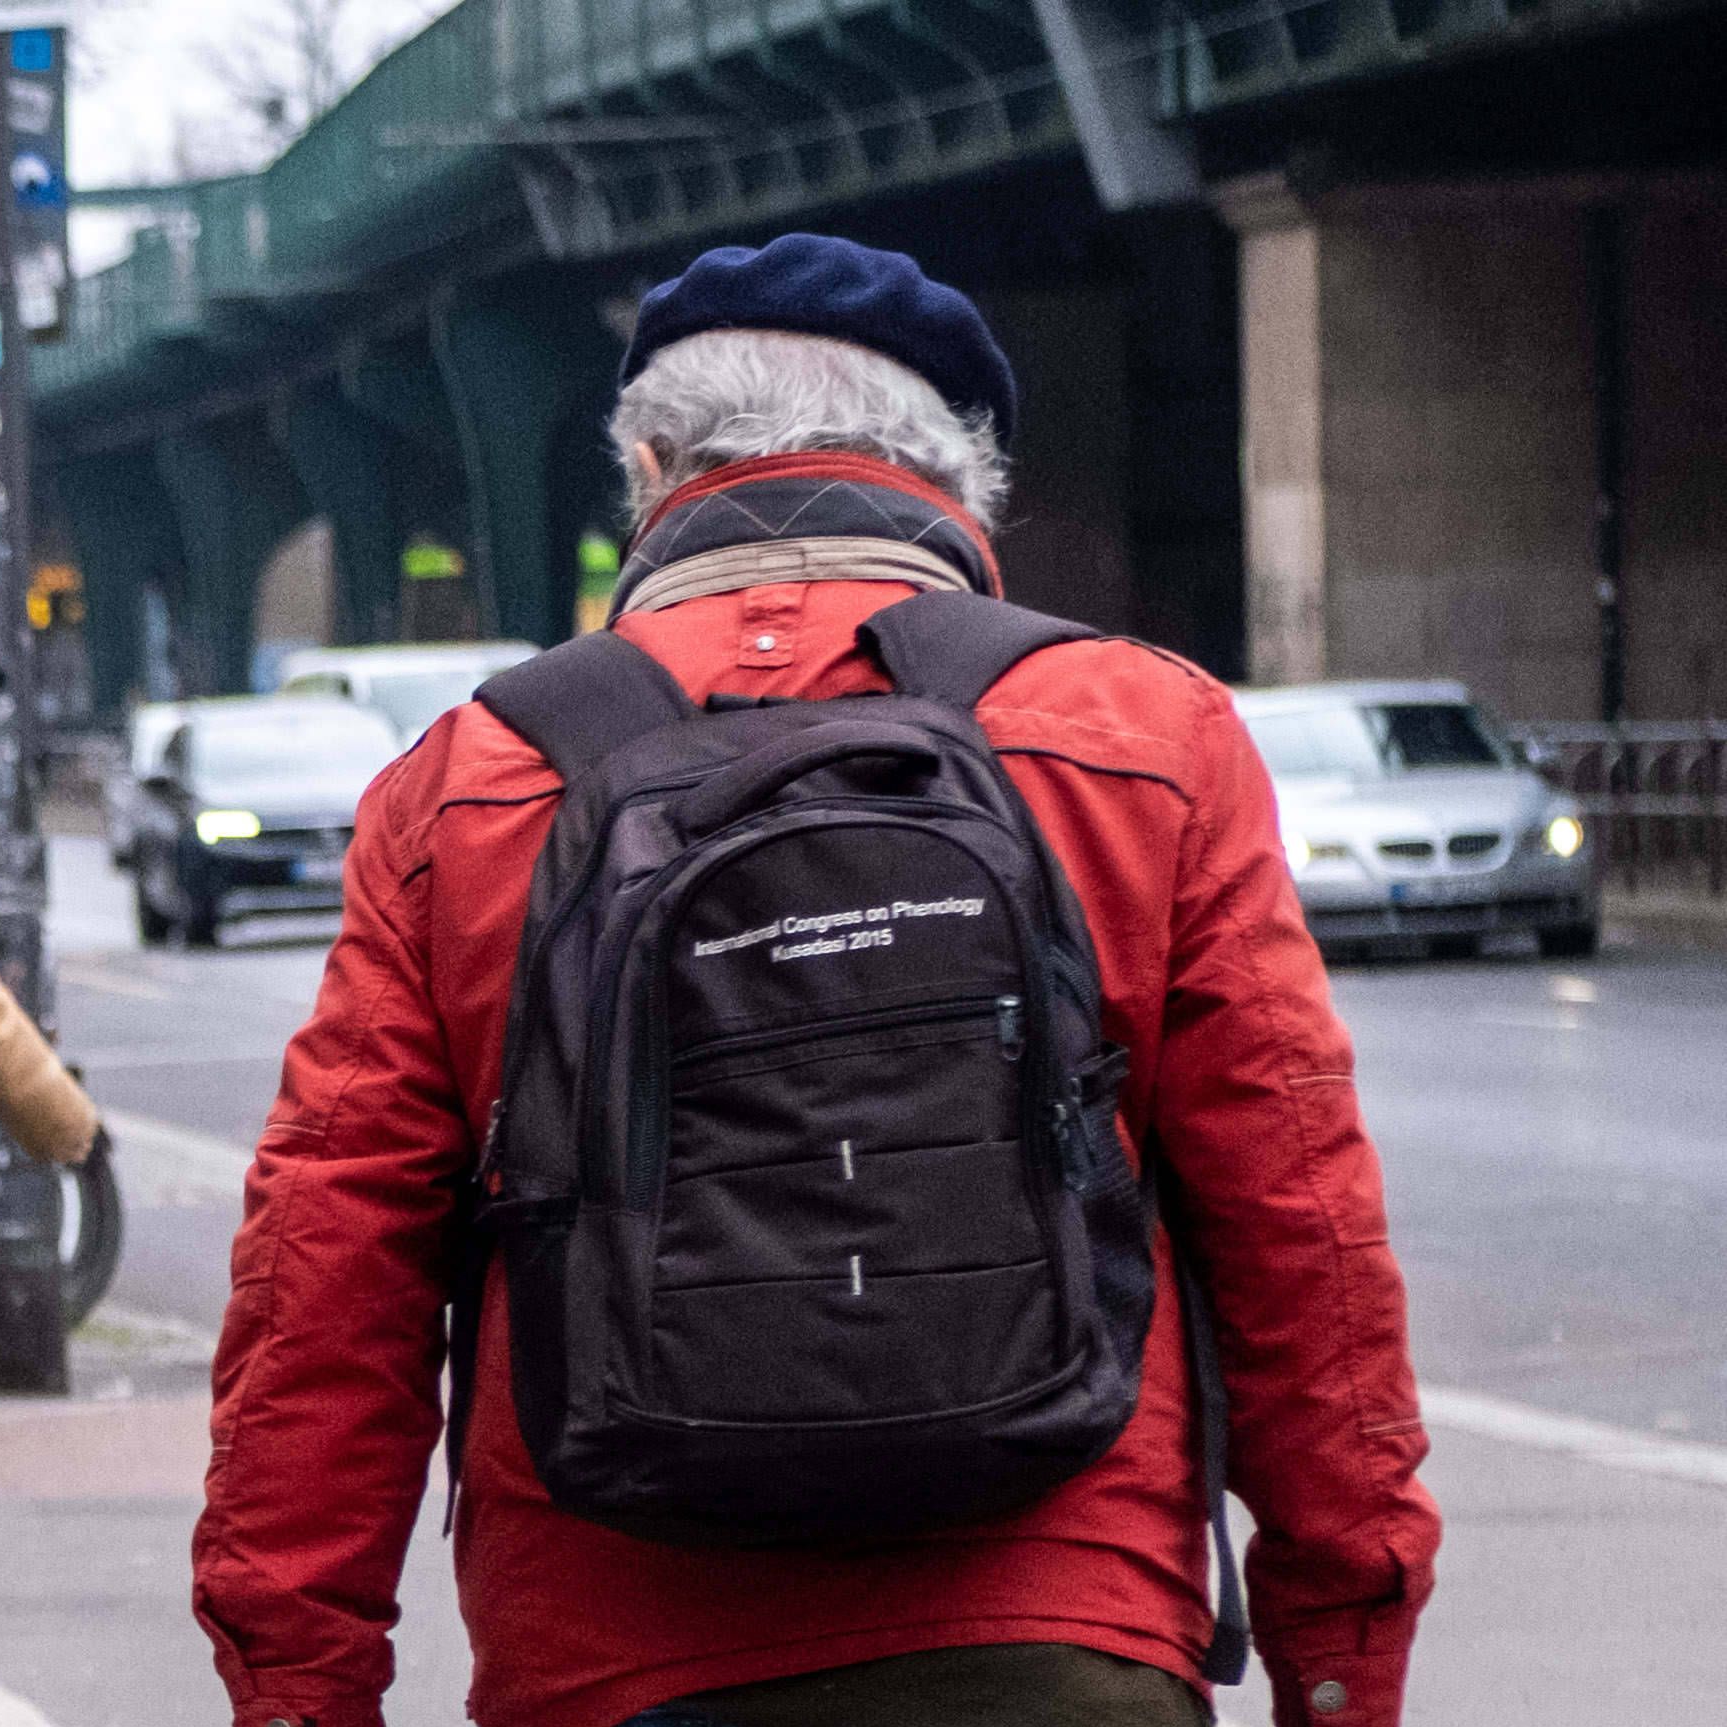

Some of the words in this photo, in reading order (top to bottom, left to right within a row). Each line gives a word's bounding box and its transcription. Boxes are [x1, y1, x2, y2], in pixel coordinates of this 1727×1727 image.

[694, 920, 781, 957] International
[782, 910, 863, 934] Congress
[865, 906, 889, 922] on
[890, 897, 985, 919] Phenology
[848, 928, 893, 950] 2015
